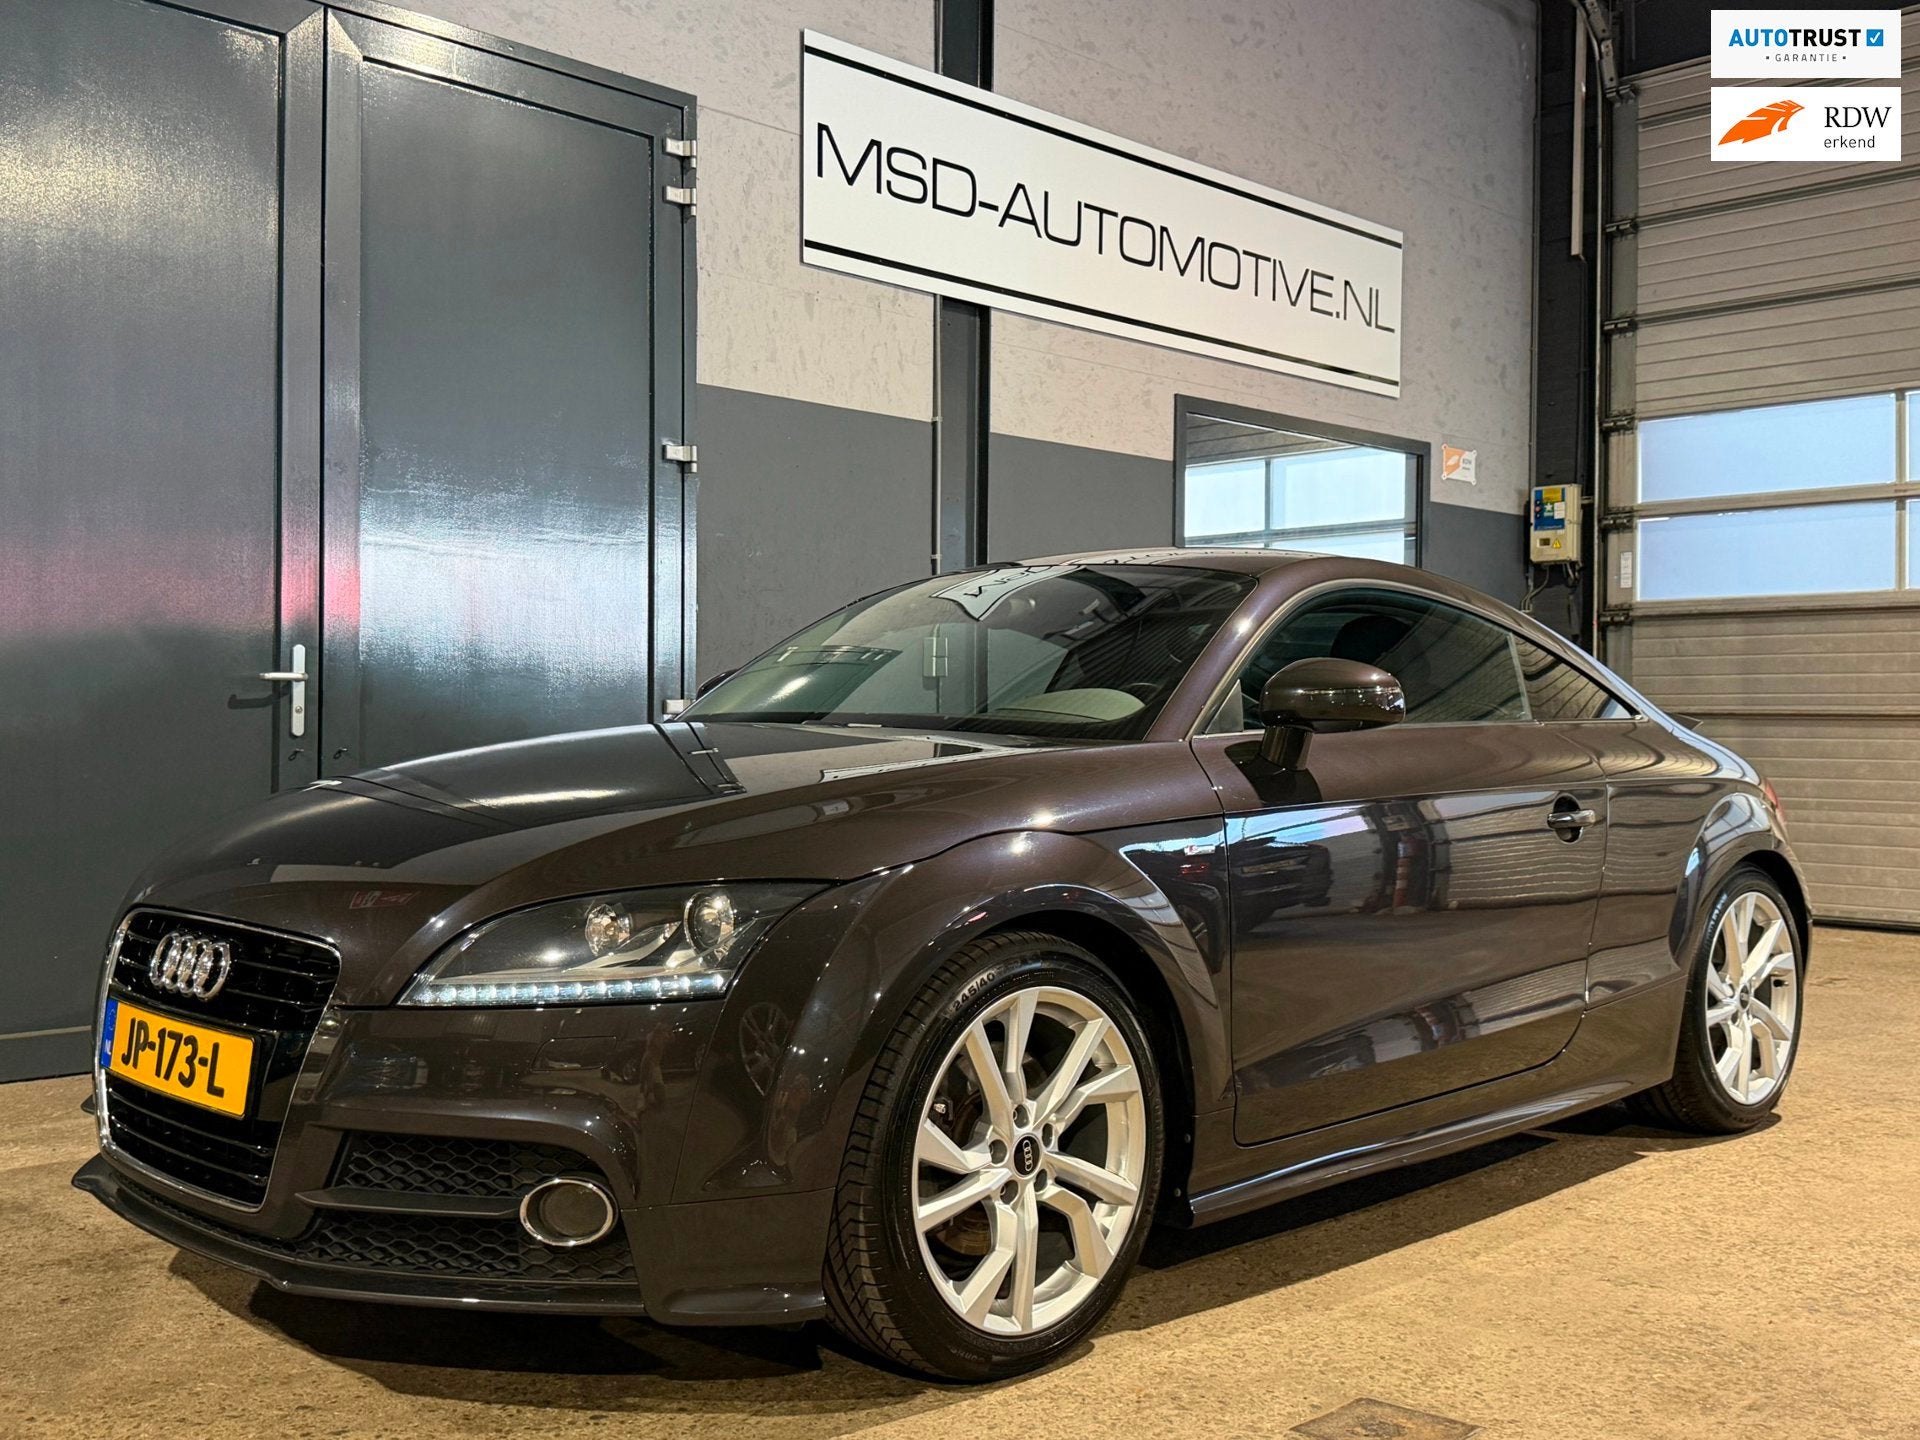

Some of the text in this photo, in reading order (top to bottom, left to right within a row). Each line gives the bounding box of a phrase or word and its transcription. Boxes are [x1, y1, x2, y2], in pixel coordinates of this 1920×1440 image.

[816, 121, 1396, 333] MSD-AUTOMOTIVE.NL
[954, 972, 995, 1011] 245/40
[121, 1017, 224, 1098] JP-173-L
